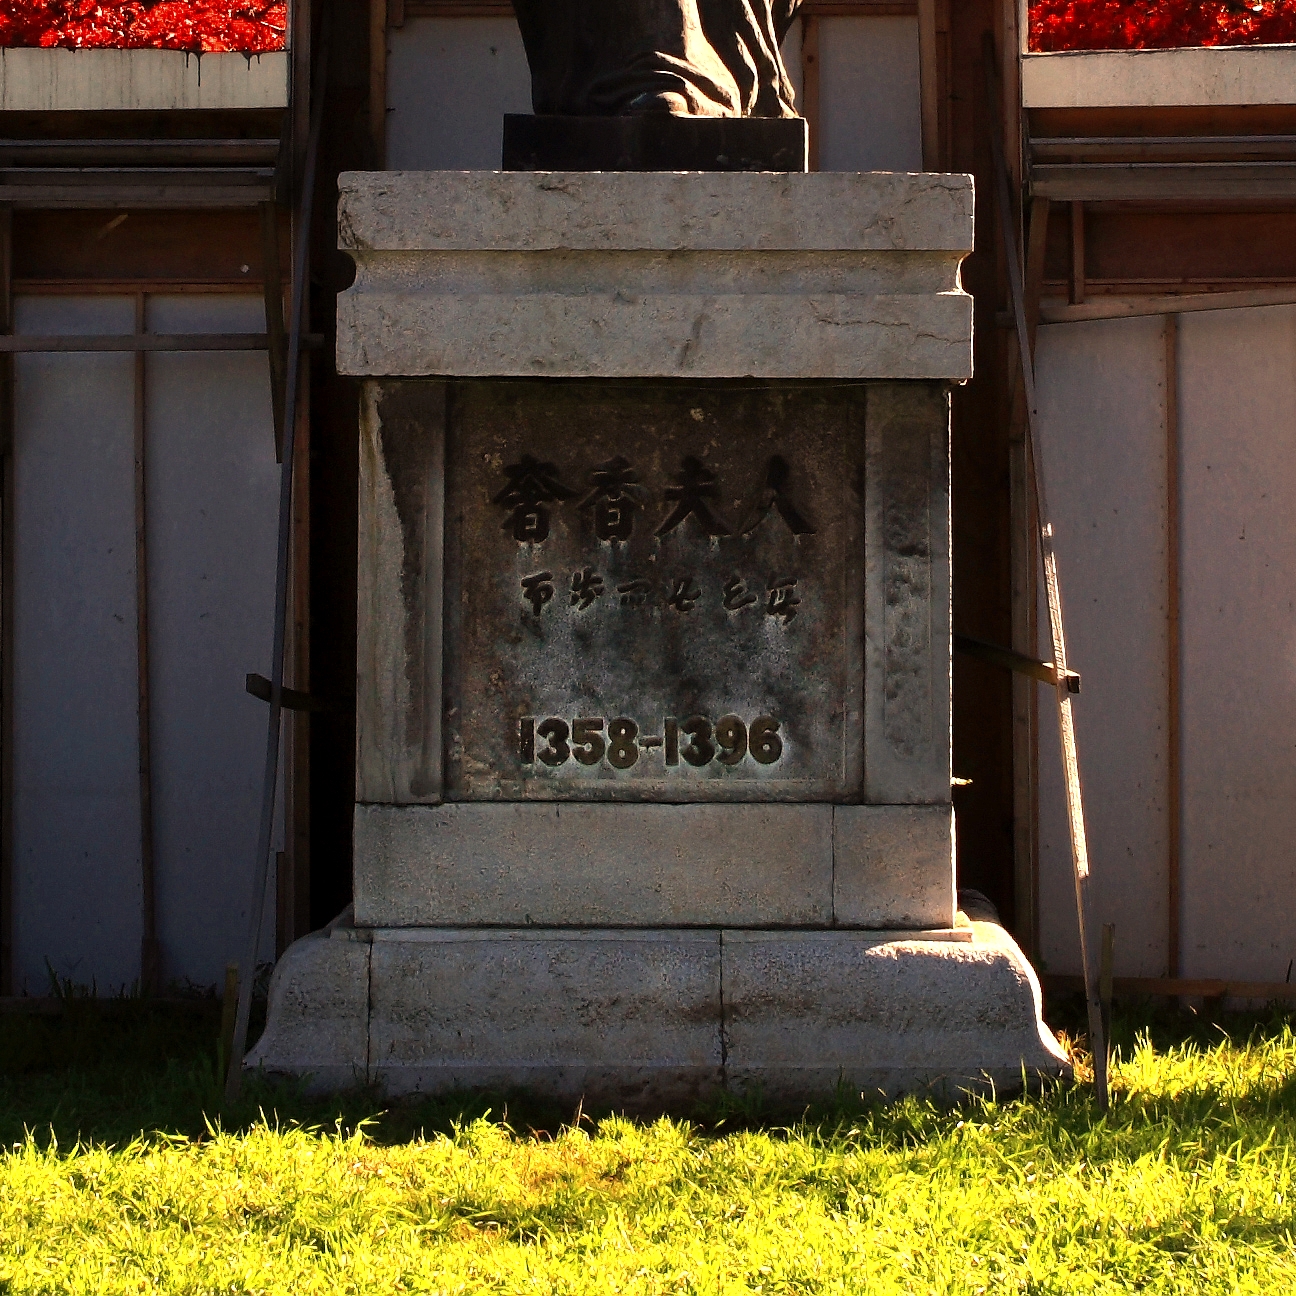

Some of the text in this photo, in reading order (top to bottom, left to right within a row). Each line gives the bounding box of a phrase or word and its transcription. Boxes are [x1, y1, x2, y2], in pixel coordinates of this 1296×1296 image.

[492, 454, 817, 543] 奢香夫人
[519, 714, 783, 769] 1358-1396
